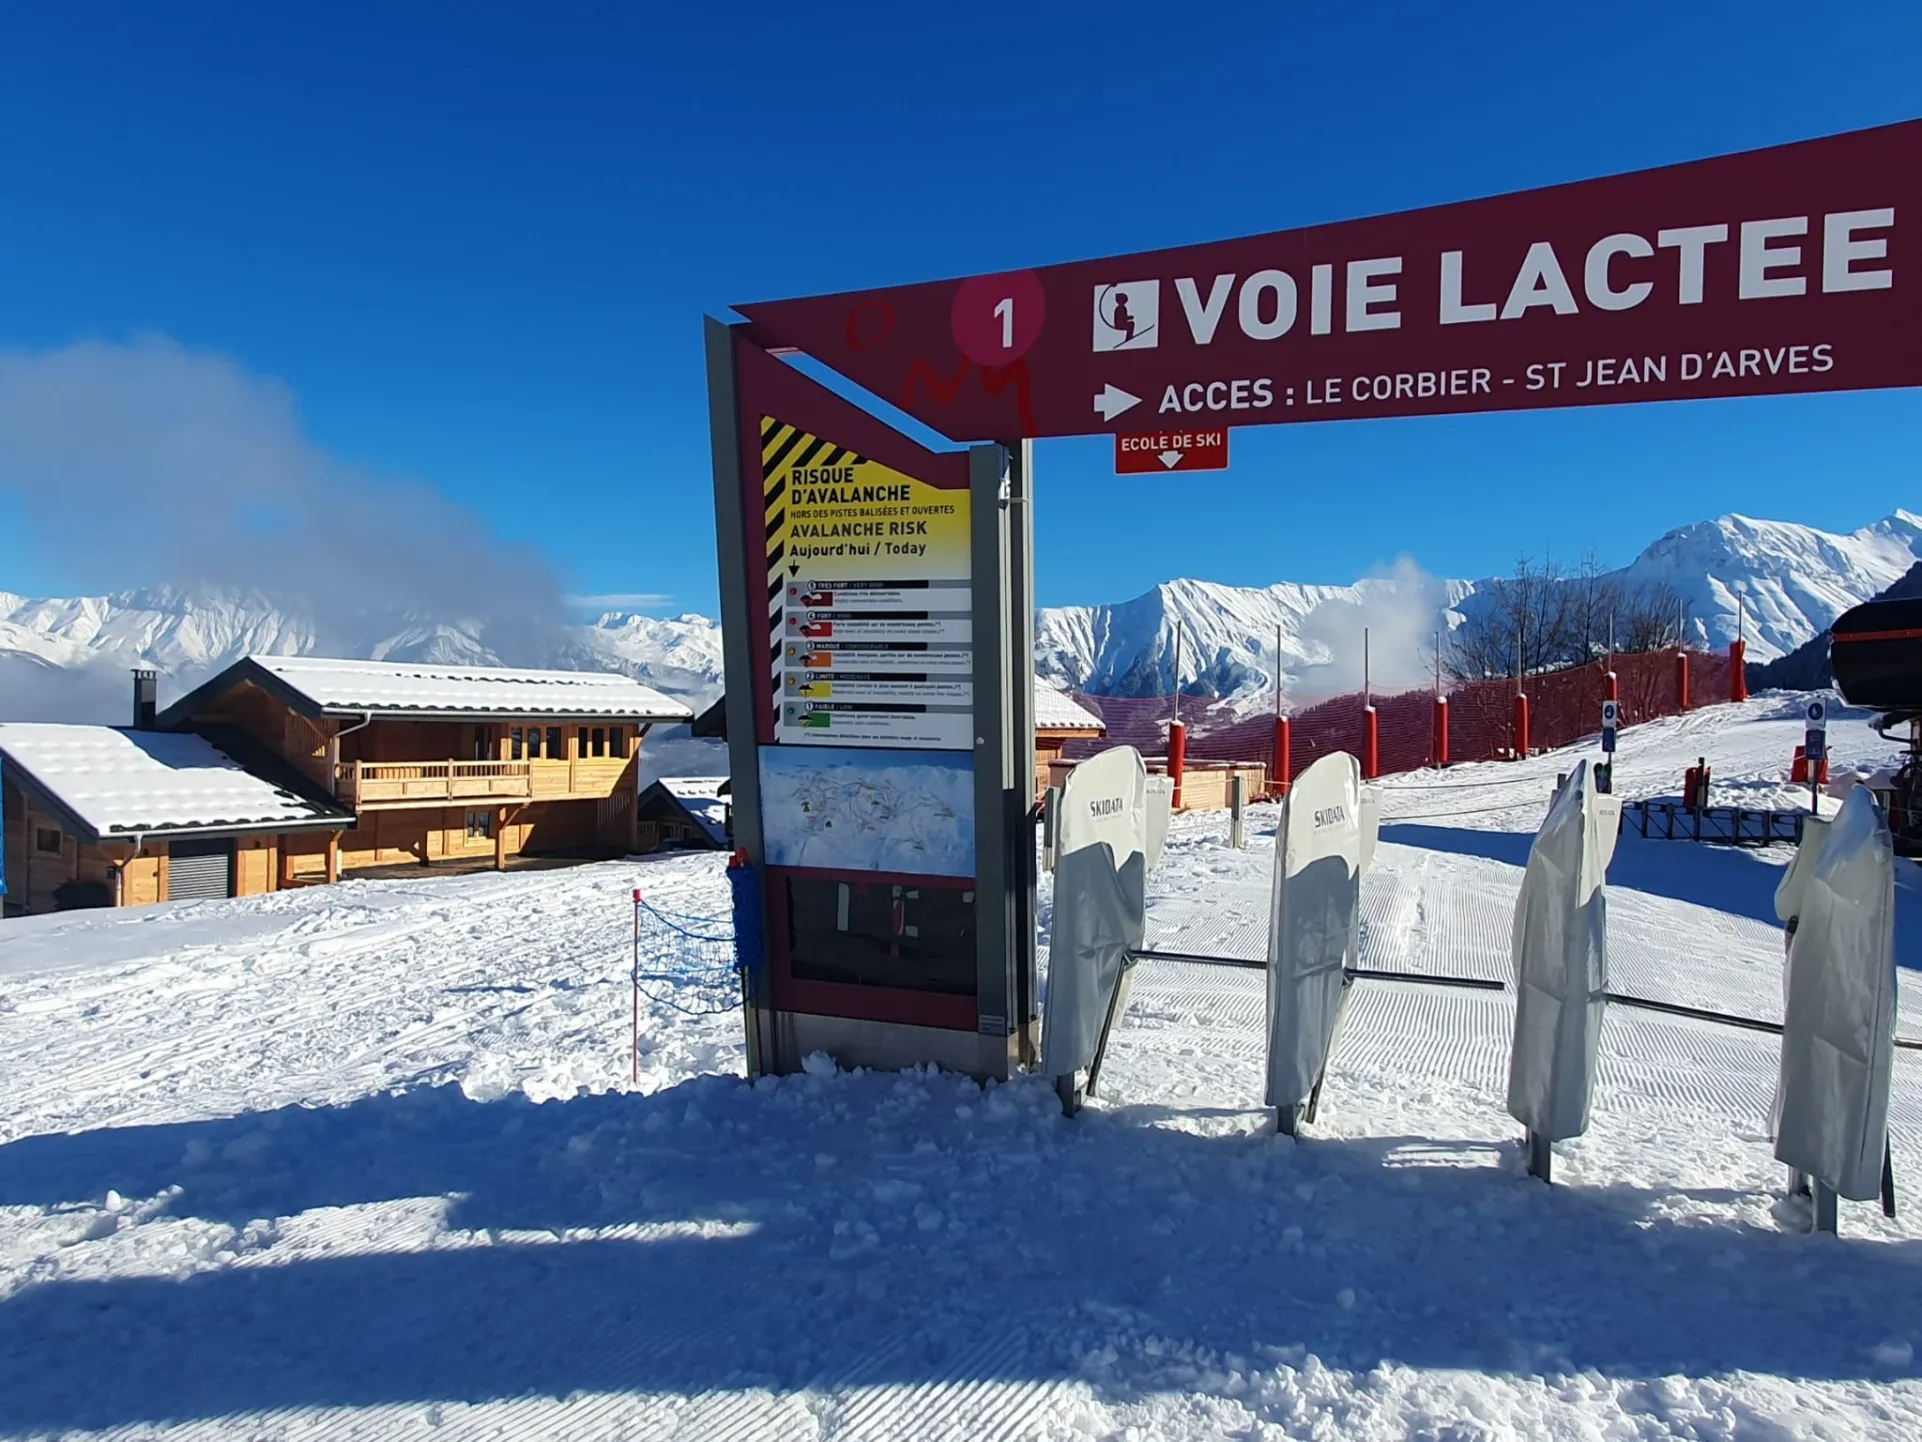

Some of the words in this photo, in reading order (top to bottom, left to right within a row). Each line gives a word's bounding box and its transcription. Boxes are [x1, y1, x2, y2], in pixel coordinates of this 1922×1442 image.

[1174, 256, 1403, 345] VOIE
[1439, 208, 1895, 325] LACTEE
[993, 298, 1014, 348] 1
[1158, 378, 1274, 414] ACCES
[1306, 378, 1342, 405] LE
[1352, 368, 1491, 401] CORBIER
[1526, 362, 1567, 391] ST
[1576, 355, 1667, 389] JEAN
[1681, 343, 1835, 382] D'ARVES
[1121, 435, 1169, 451] ECOLE
[1172, 434, 1192, 448] DE
[1196, 432, 1221, 447] SKI
[791, 467, 855, 486] RISQUE
[791, 484, 911, 506] D'AVALANCHE
[790, 509, 812, 519] HORS
[813, 508, 828, 519] DES
[830, 507, 858, 518] PISTES
[859, 505, 898, 517] BALISÉES
[900, 506, 910, 516] ET
[912, 504, 955, 515] OUVERTES
[790, 521, 884, 539] AVALANCHE
[889, 520, 928, 536] RISK
[790, 542, 870, 560] Aujourd'hui
[884, 541, 927, 558] Today
[1090, 797, 1124, 817] SKIDATA
[1314, 805, 1346, 828] SKIDATA
